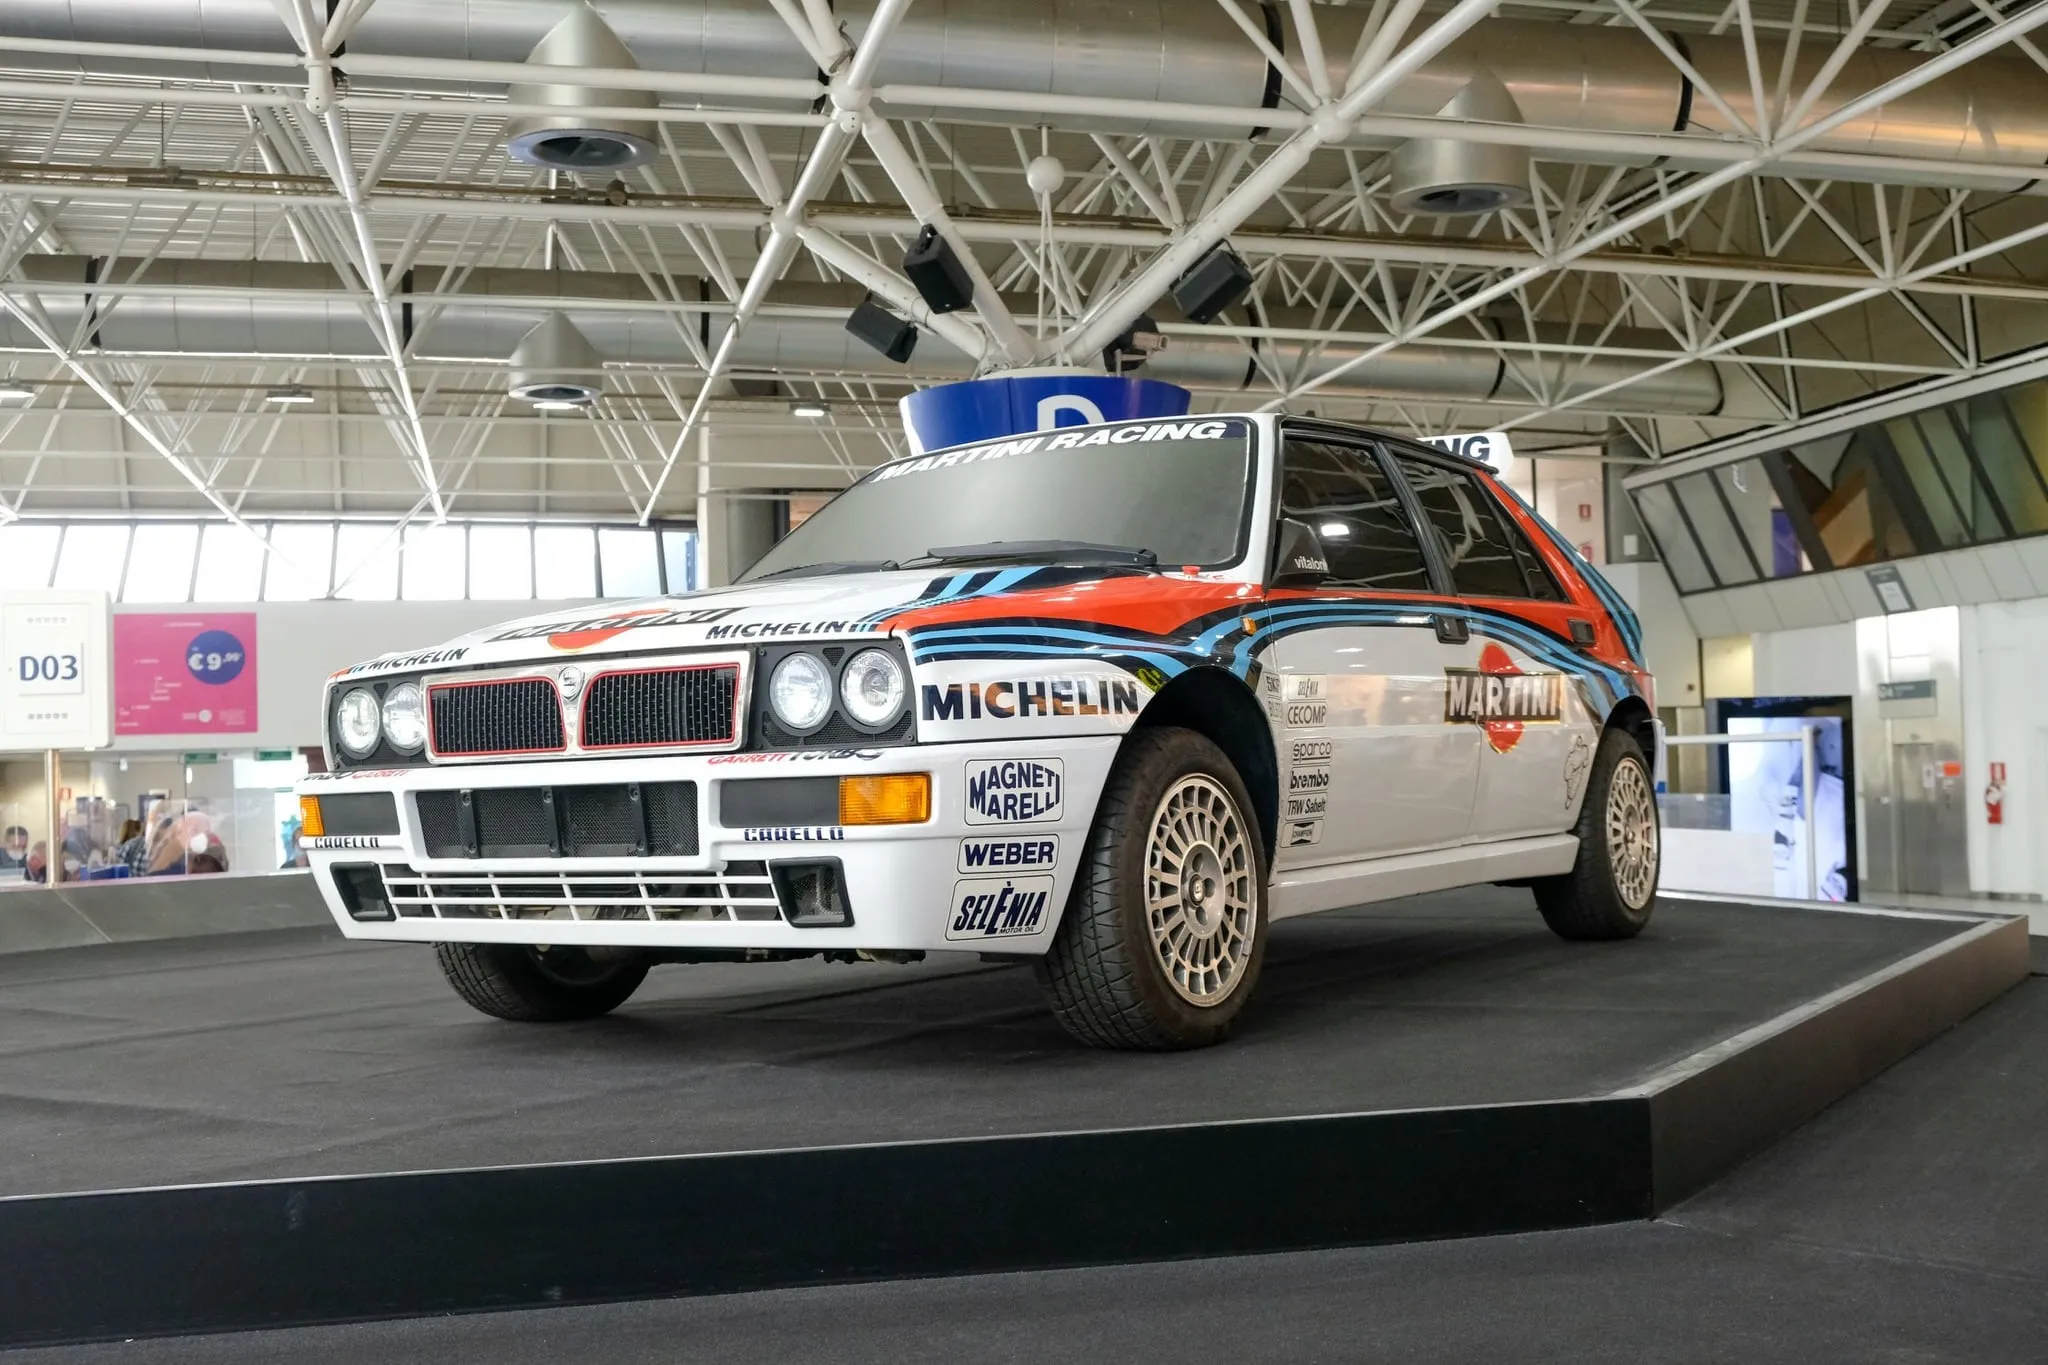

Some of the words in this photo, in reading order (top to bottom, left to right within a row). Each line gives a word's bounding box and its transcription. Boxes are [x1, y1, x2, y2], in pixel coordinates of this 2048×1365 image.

[870, 437, 1045, 483] MARTINI
[1046, 421, 1227, 451] RACING
[705, 619, 848, 640] MICHELIN
[20, 655, 78, 681] D03
[368, 647, 470, 671] MICHELIN
[922, 680, 1138, 721] MICHELIN
[1449, 675, 1557, 716] MARTINI
[1288, 705, 1327, 724] CECOMP
[1293, 742, 1332, 763] sparco
[970, 762, 1060, 798] MAGNETI
[1290, 769, 1329, 789] brembo
[970, 783, 1060, 820] MARELLI
[1288, 800, 1305, 815] TRW
[1305, 798, 1326, 814] Sabelt
[965, 841, 1055, 867] WEBER
[953, 881, 1047, 935] SELÈNIA
